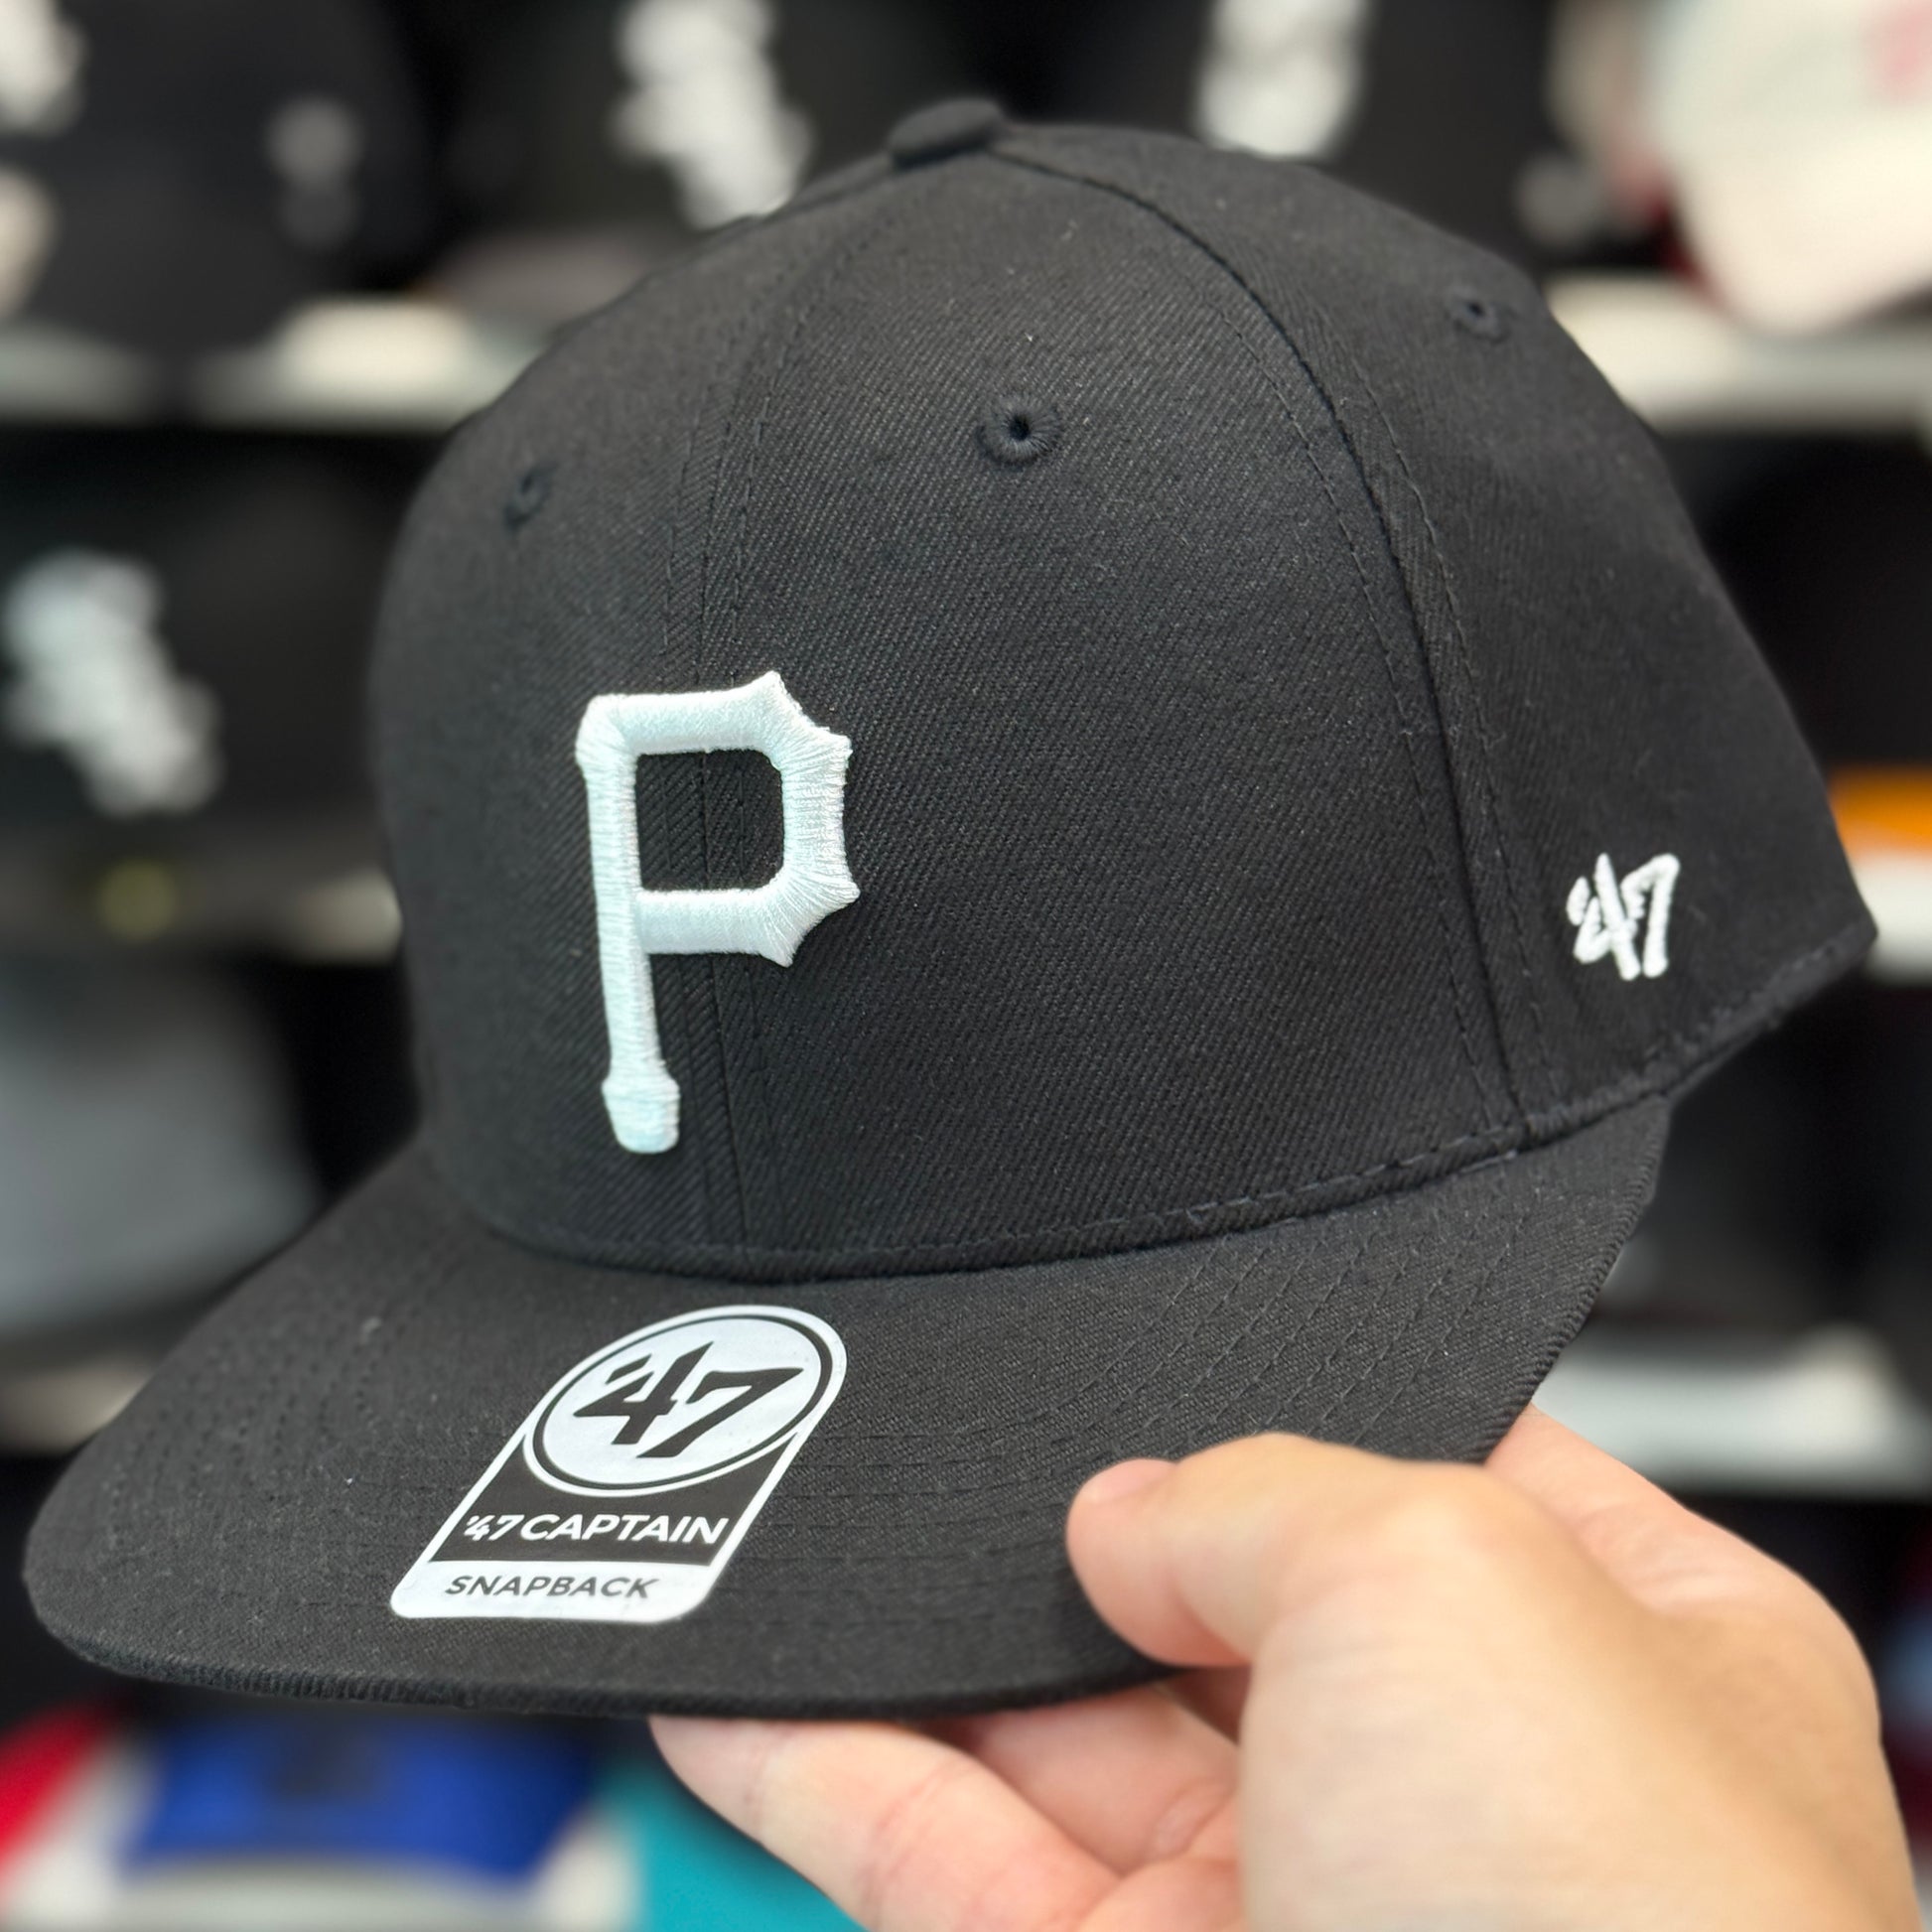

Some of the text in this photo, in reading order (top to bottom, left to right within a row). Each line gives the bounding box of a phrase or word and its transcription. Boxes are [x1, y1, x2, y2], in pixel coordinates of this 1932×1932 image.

[575, 670, 861, 1155] P
[520, 1514, 730, 1545] CAPTAIN
[445, 1575, 659, 1599] SNAPBACK
